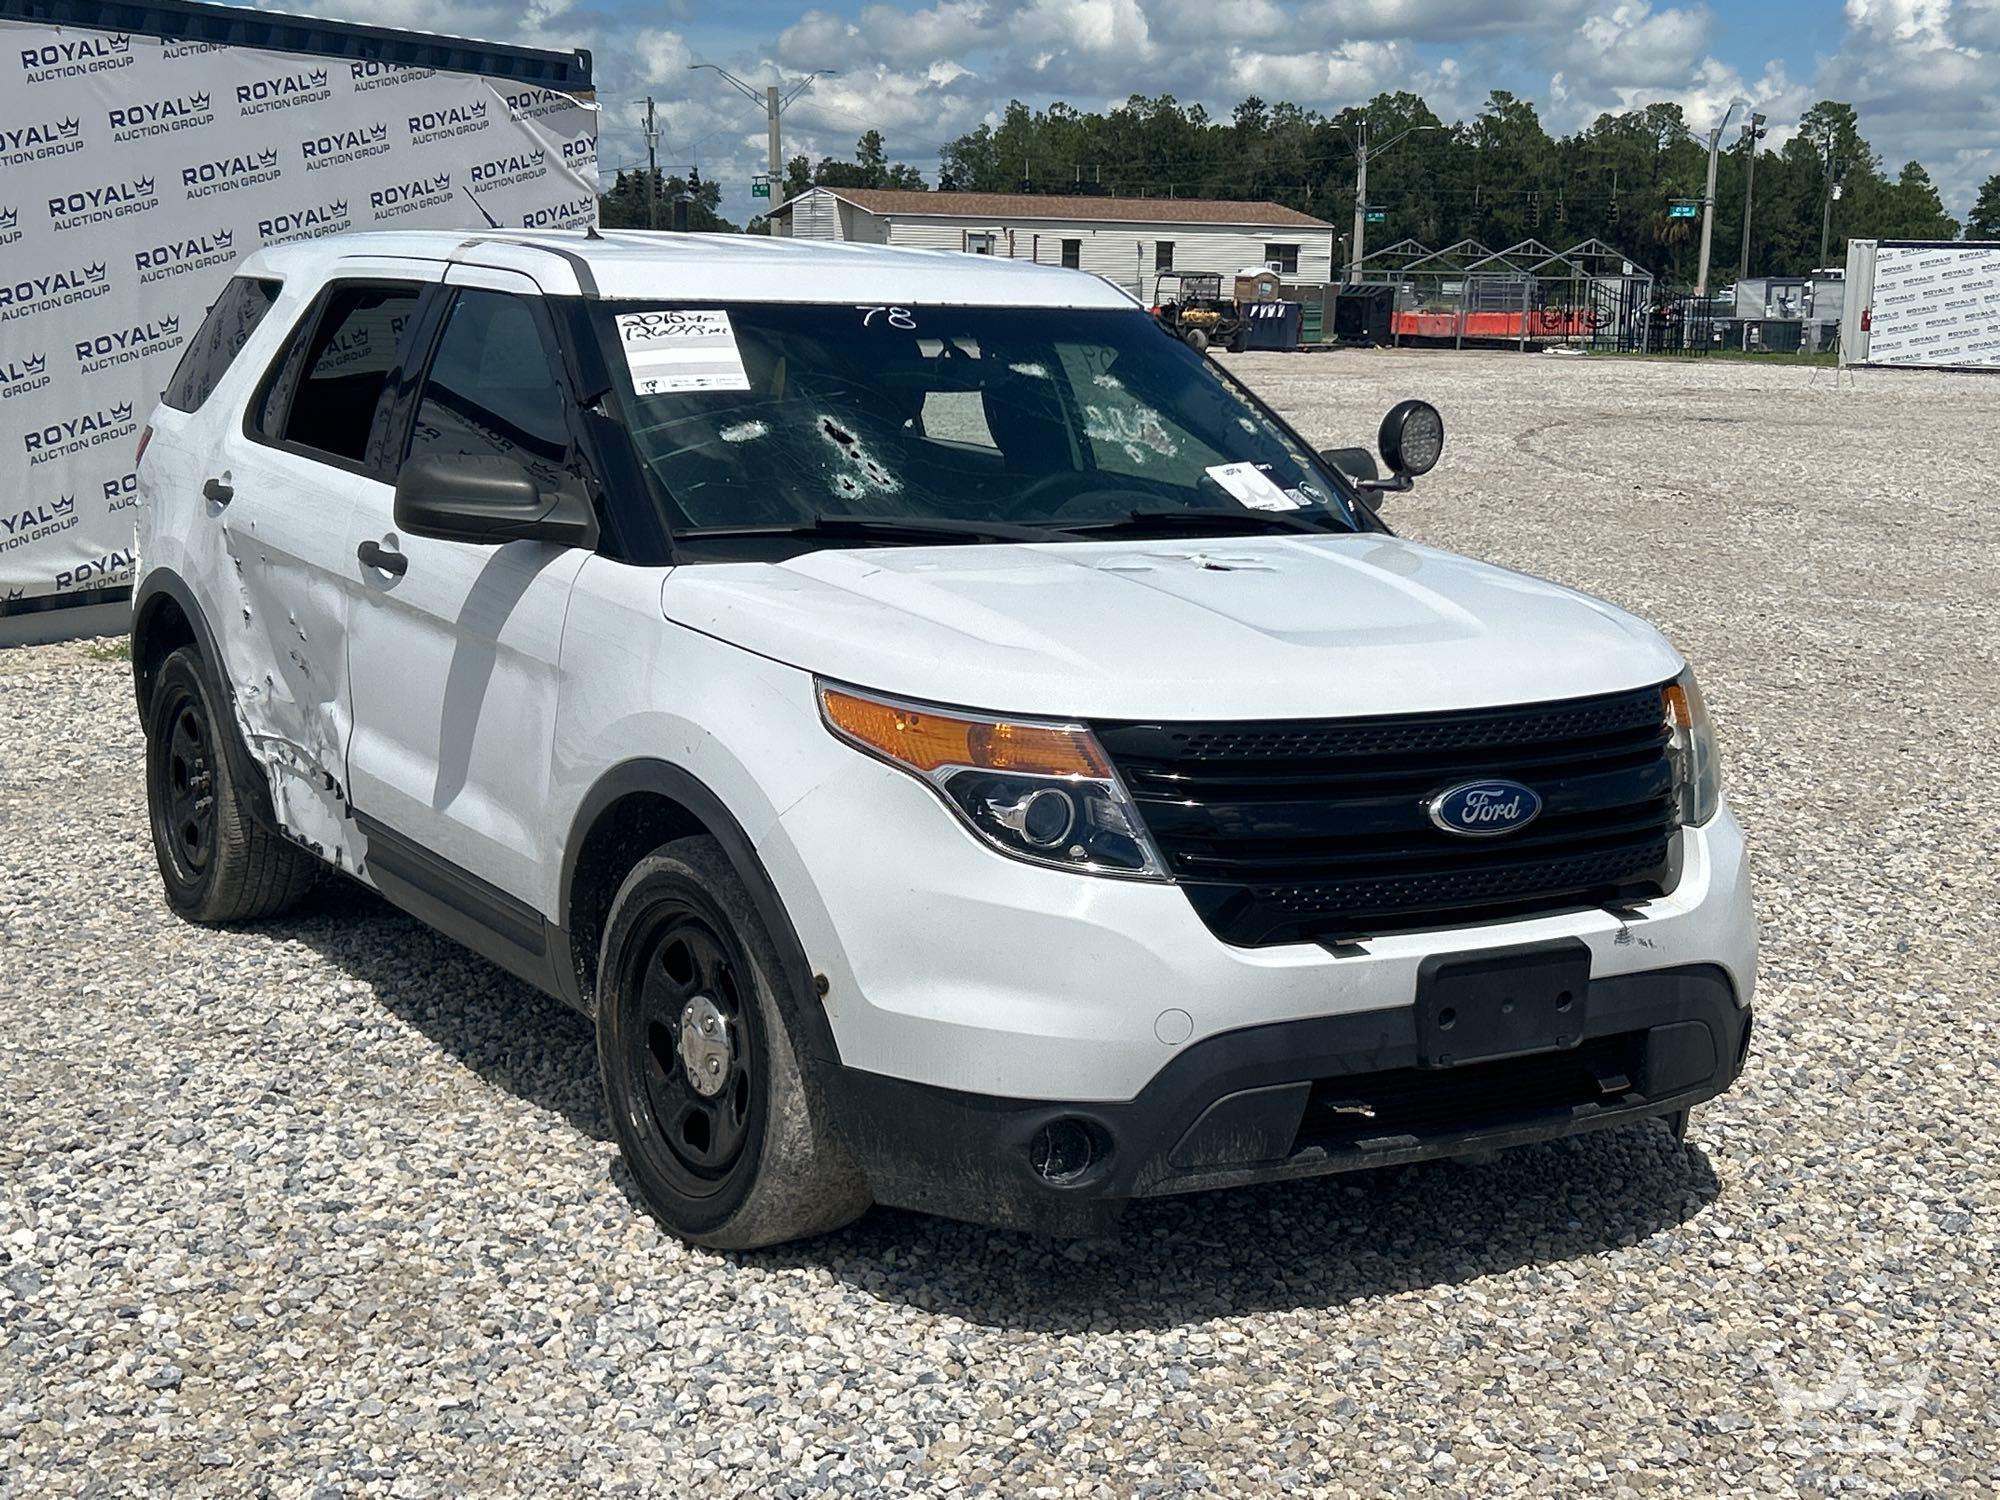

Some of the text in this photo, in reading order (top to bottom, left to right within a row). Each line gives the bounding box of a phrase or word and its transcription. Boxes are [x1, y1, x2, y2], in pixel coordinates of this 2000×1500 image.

[22, 39, 110, 68] ROYAL
[163, 43, 216, 59] AUCTION
[26, 56, 134, 84] AUCTION GROUP
[354, 68, 436, 92] AUCTION GROUP
[236, 75, 310, 103] ROYAL
[241, 90, 331, 116] AUCTION GROUP
[109, 98, 190, 128] ROYAL
[408, 106, 470, 133] ROYAL
[510, 100, 577, 122] AUCTION GROU
[0, 124, 58, 152] YAL
[114, 114, 214, 142] AUCTION GROUP
[412, 120, 489, 146] AUCTION GROUP
[0, 141, 84, 166] TION GROUP
[302, 129, 371, 158] ROYAL
[306, 144, 390, 171] AUCTION GROUP
[563, 137, 597, 158] ROY
[182, 155, 258, 186] ROYAL
[471, 155, 530, 182] ROYAL
[566, 155, 597, 168] AUCTIO
[187, 170, 281, 200] AUCTION GROUP
[370, 179, 434, 208] ROYAL
[474, 168, 546, 194] AUCTION GROUP
[49, 184, 135, 217] ROYAL
[374, 192, 453, 220] AUCTION GROUP
[54, 199, 159, 231] AUCTION GROUP
[258, 207, 331, 238] ROYAL
[315, 220, 351, 238] GROUP
[523, 202, 580, 228] ROYAL
[566, 214, 596, 230] GROUP
[135, 237, 213, 270] ROYAL
[140, 251, 236, 284] AUCTION GROUP
[0, 270, 84, 307] ROYAL
[2, 284, 110, 322] AUCTION GROUP
[856, 306, 916, 329] 78
[76, 323, 160, 361] ROYAL
[81, 337, 183, 375] AUCTION GROUP
[3, 376, 50, 398] GROUP
[24, 412, 111, 452] ROYAL
[30, 424, 136, 466] AUCTION GROUP
[0, 506, 52, 534] YAL
[0, 516, 79, 552] TION GROUP
[56, 548, 136, 590] ROYAL
[1462, 790, 1521, 824] Ford
